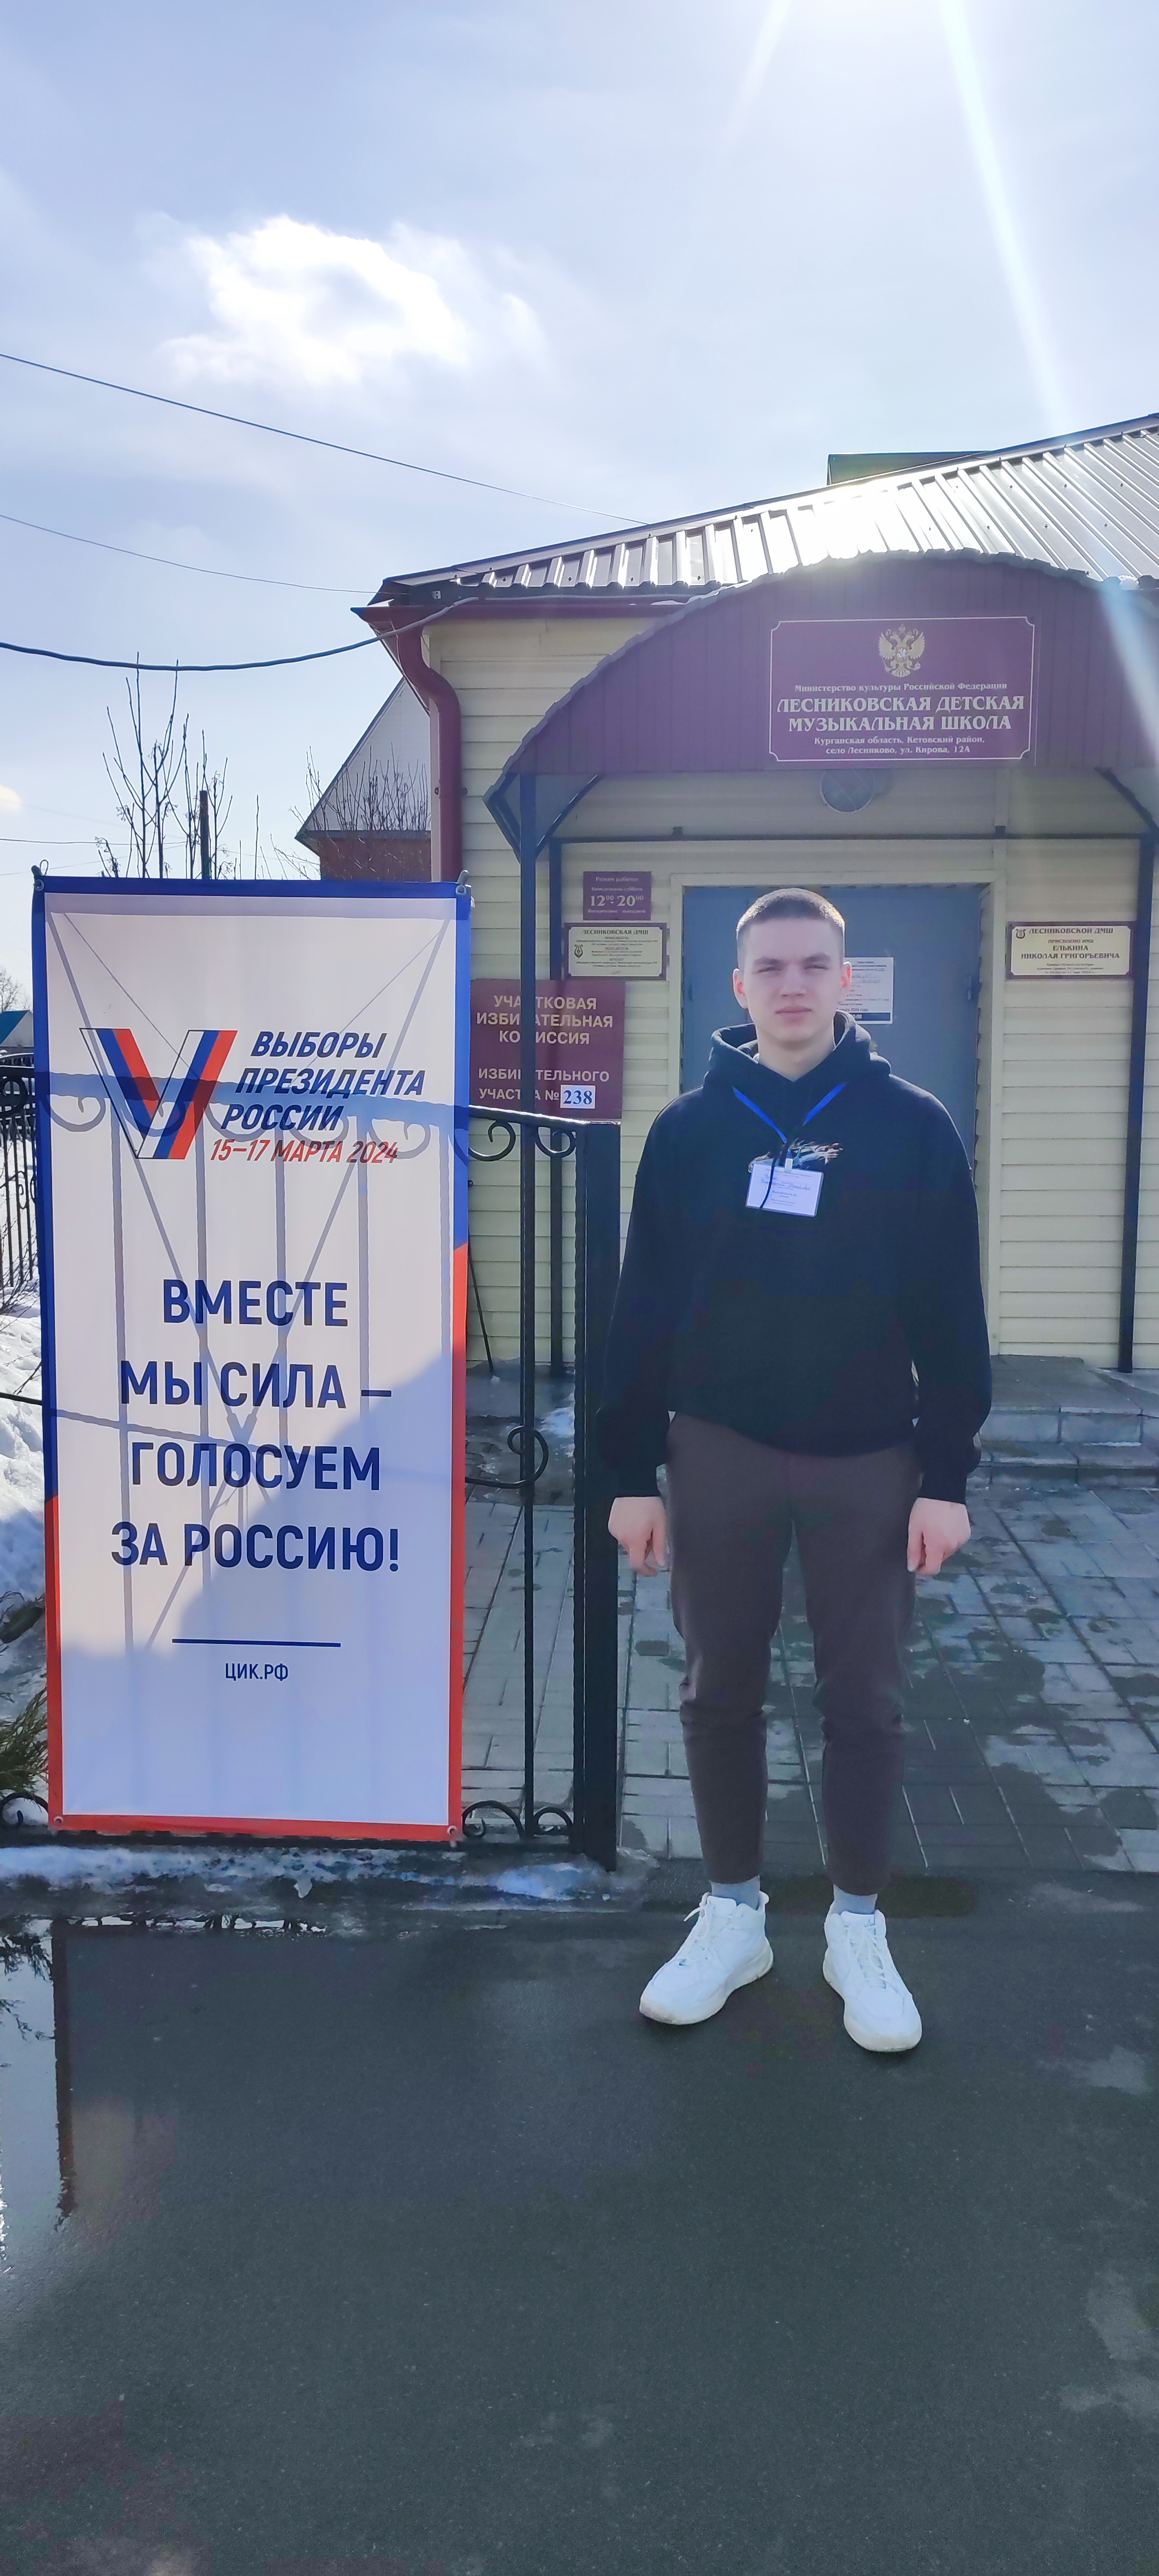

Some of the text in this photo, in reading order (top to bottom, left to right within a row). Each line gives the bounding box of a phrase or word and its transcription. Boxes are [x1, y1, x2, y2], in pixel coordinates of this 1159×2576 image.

[795, 685, 856, 693] Министерство
[859, 683, 901, 692] культуры
[958, 682, 1007, 691] Федерации
[777, 696, 1025, 713] ЛЕСНИКОВСКАЯ ДЕТСКАЯ
[789, 715, 1011, 732] МУЗЫКАЛЬНАЯ ШКОЛА
[814, 736, 985, 746] Курганская область, Кетовский район,
[915, 747, 950, 755] Кирова,
[494, 995, 597, 1009] УЧАТКОВАЯ
[476, 1012, 613, 1027] ИЗБИАТЕЛЬНАЯ
[250, 1031, 388, 1058] ВЫБОРЫ
[500, 1030, 590, 1044] КОИССИЯ
[234, 1068, 426, 1099] ПРЕЗИДЕНТА
[478, 1068, 610, 1082] ИЗБИТЕЛЬНОГО
[478, 1088, 542, 1100] УЧАСТА
[563, 1090, 592, 1104] 238
[220, 1104, 344, 1131] РОССИИ
[271, 1140, 344, 1163] МАРТА
[346, 1141, 399, 1164] 2024
[163, 1279, 349, 1326] ВМЕСТЕ
[120, 1360, 203, 1406] МЫ
[220, 1362, 347, 1409] СИЛА
[132, 1442, 381, 1491] ГОЛОСУЕМ
[111, 1521, 400, 1572] ЗА РОССИЮ!
[225, 1663, 289, 1682] ЦИК.РФ
